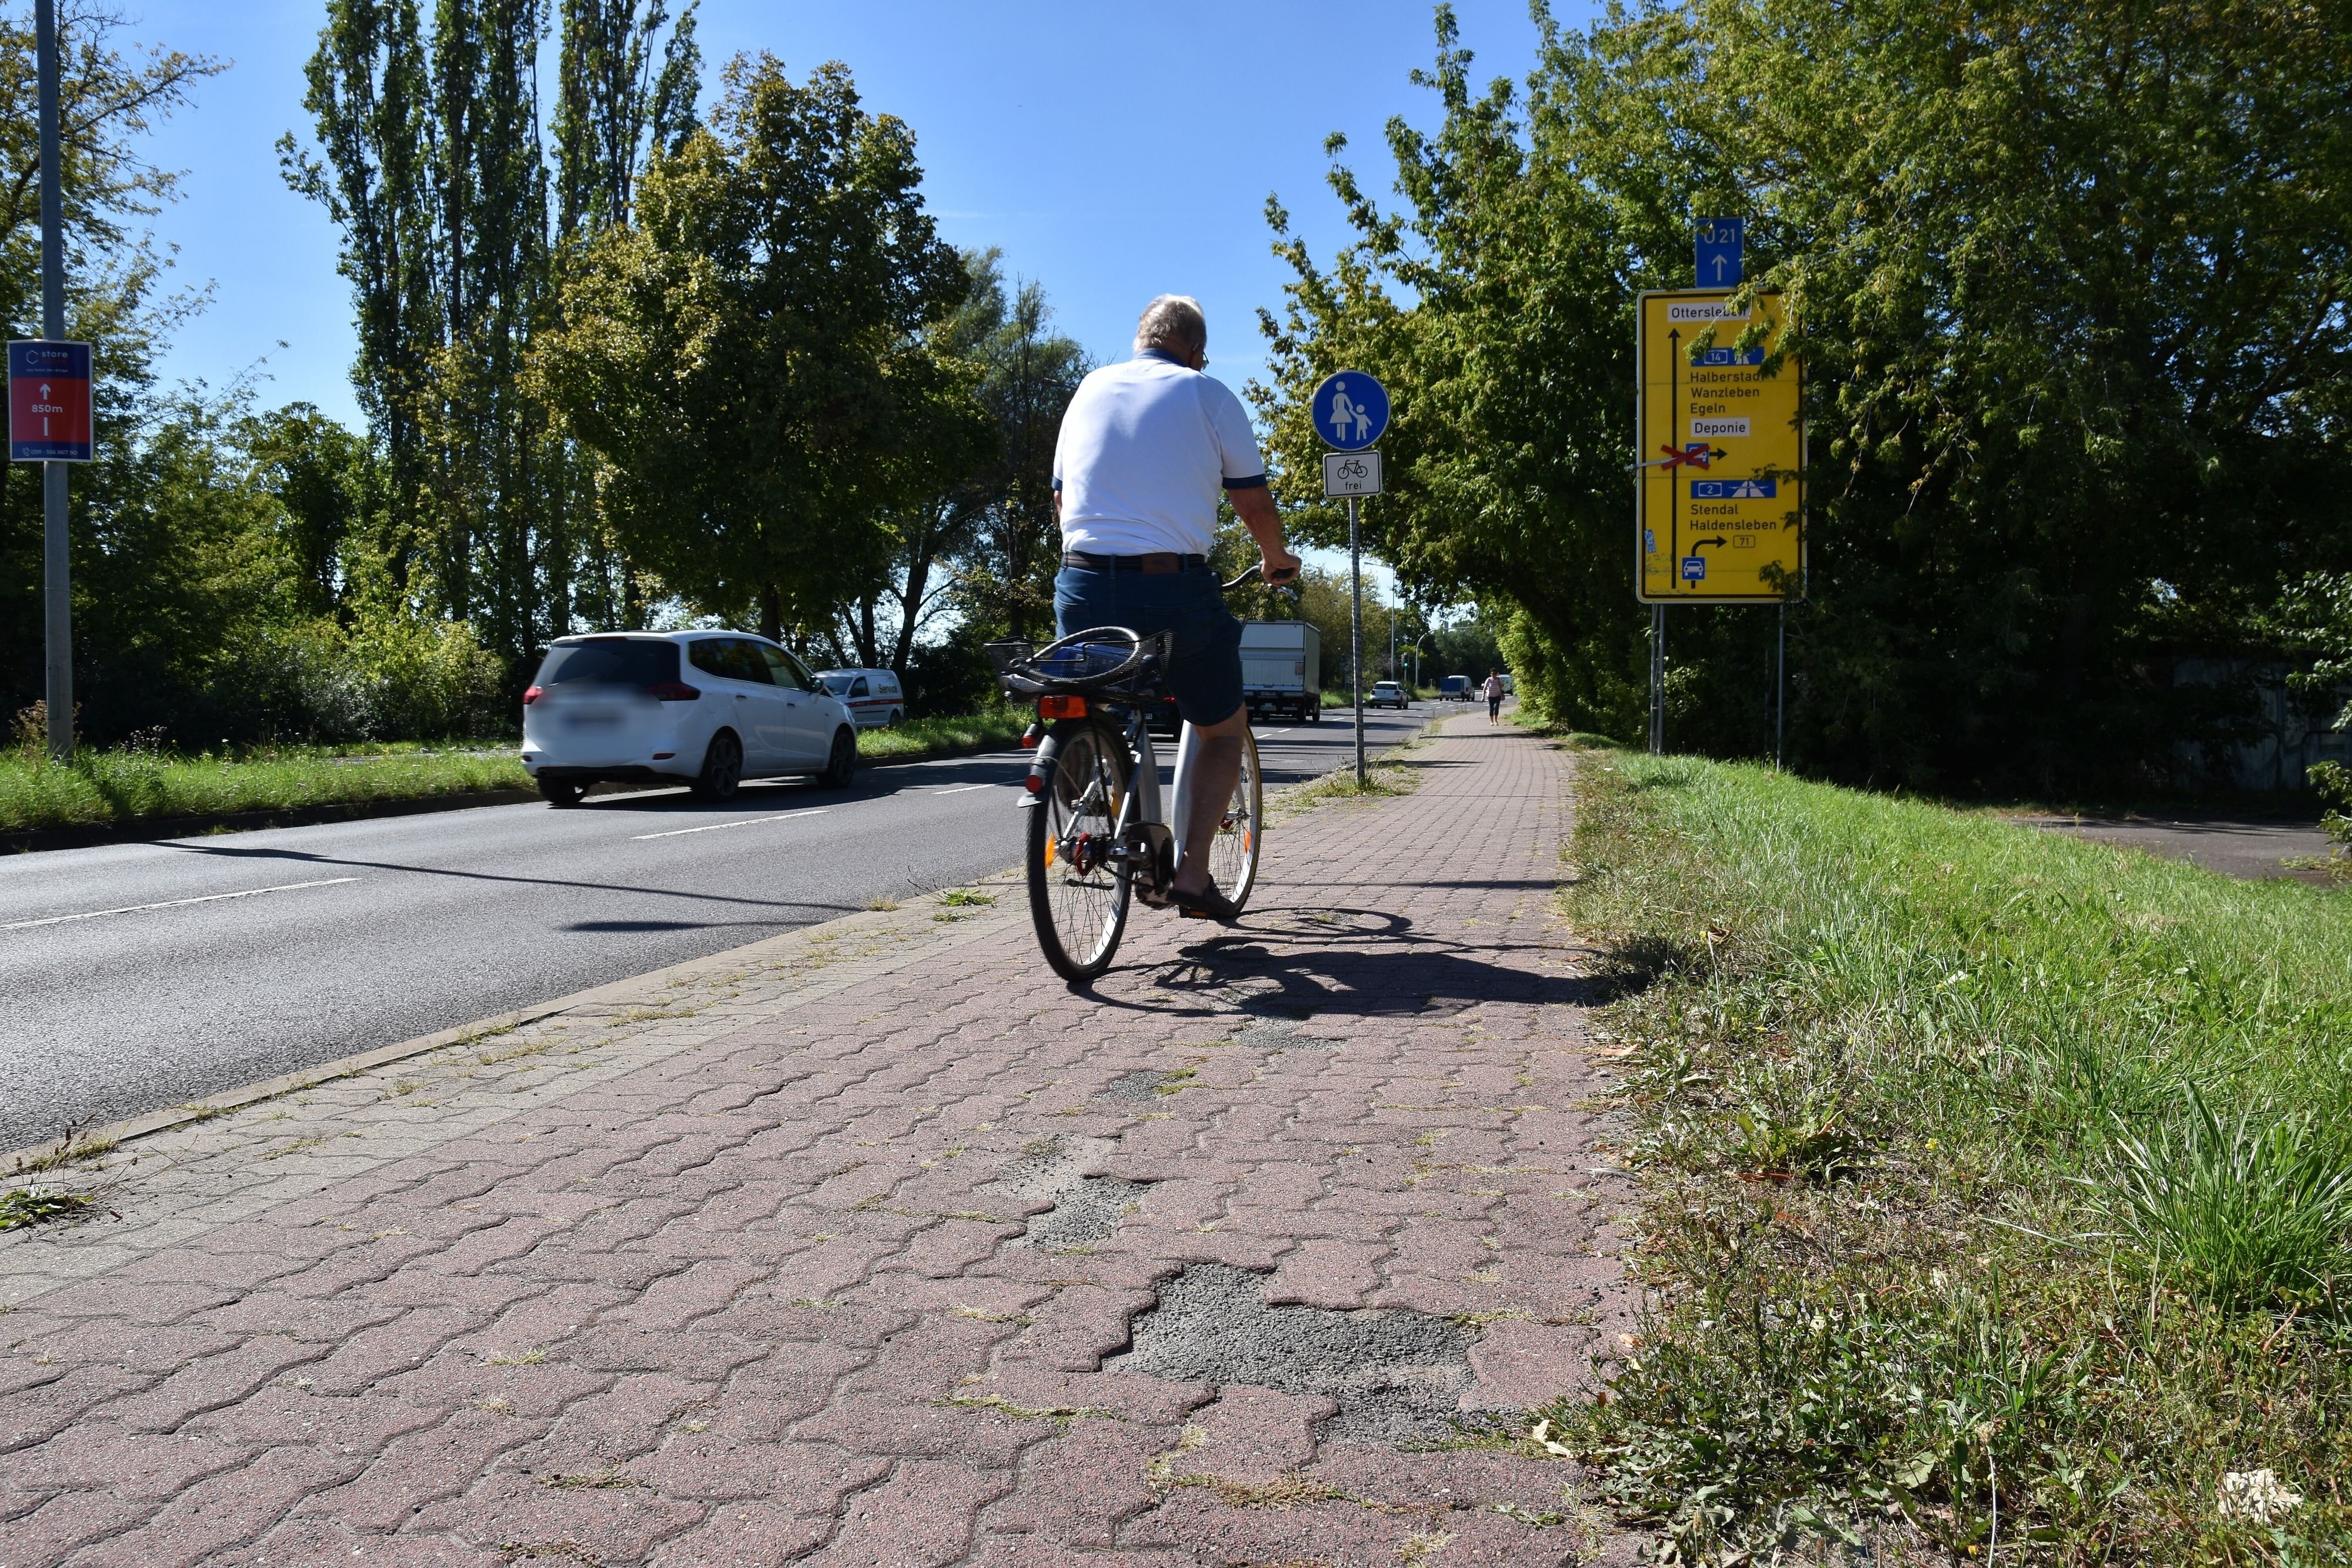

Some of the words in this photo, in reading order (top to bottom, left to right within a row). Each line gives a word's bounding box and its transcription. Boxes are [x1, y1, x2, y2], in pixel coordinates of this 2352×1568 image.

[1719, 228, 1735, 243] 21
[1710, 352, 1721, 362] 14
[1691, 387, 1760, 398] Wanzleben
[31, 404, 63, 413] 850m
[1690, 403, 1726, 416] Egeln
[1694, 422, 1746, 436] Deponie
[1345, 480, 1362, 490] frei
[1707, 485, 1713, 494] 2
[1690, 504, 1739, 515] Stendal
[1690, 519, 1777, 530] Haldensleben
[1739, 537, 1750, 546] 71
[878, 683, 897, 694] Service
